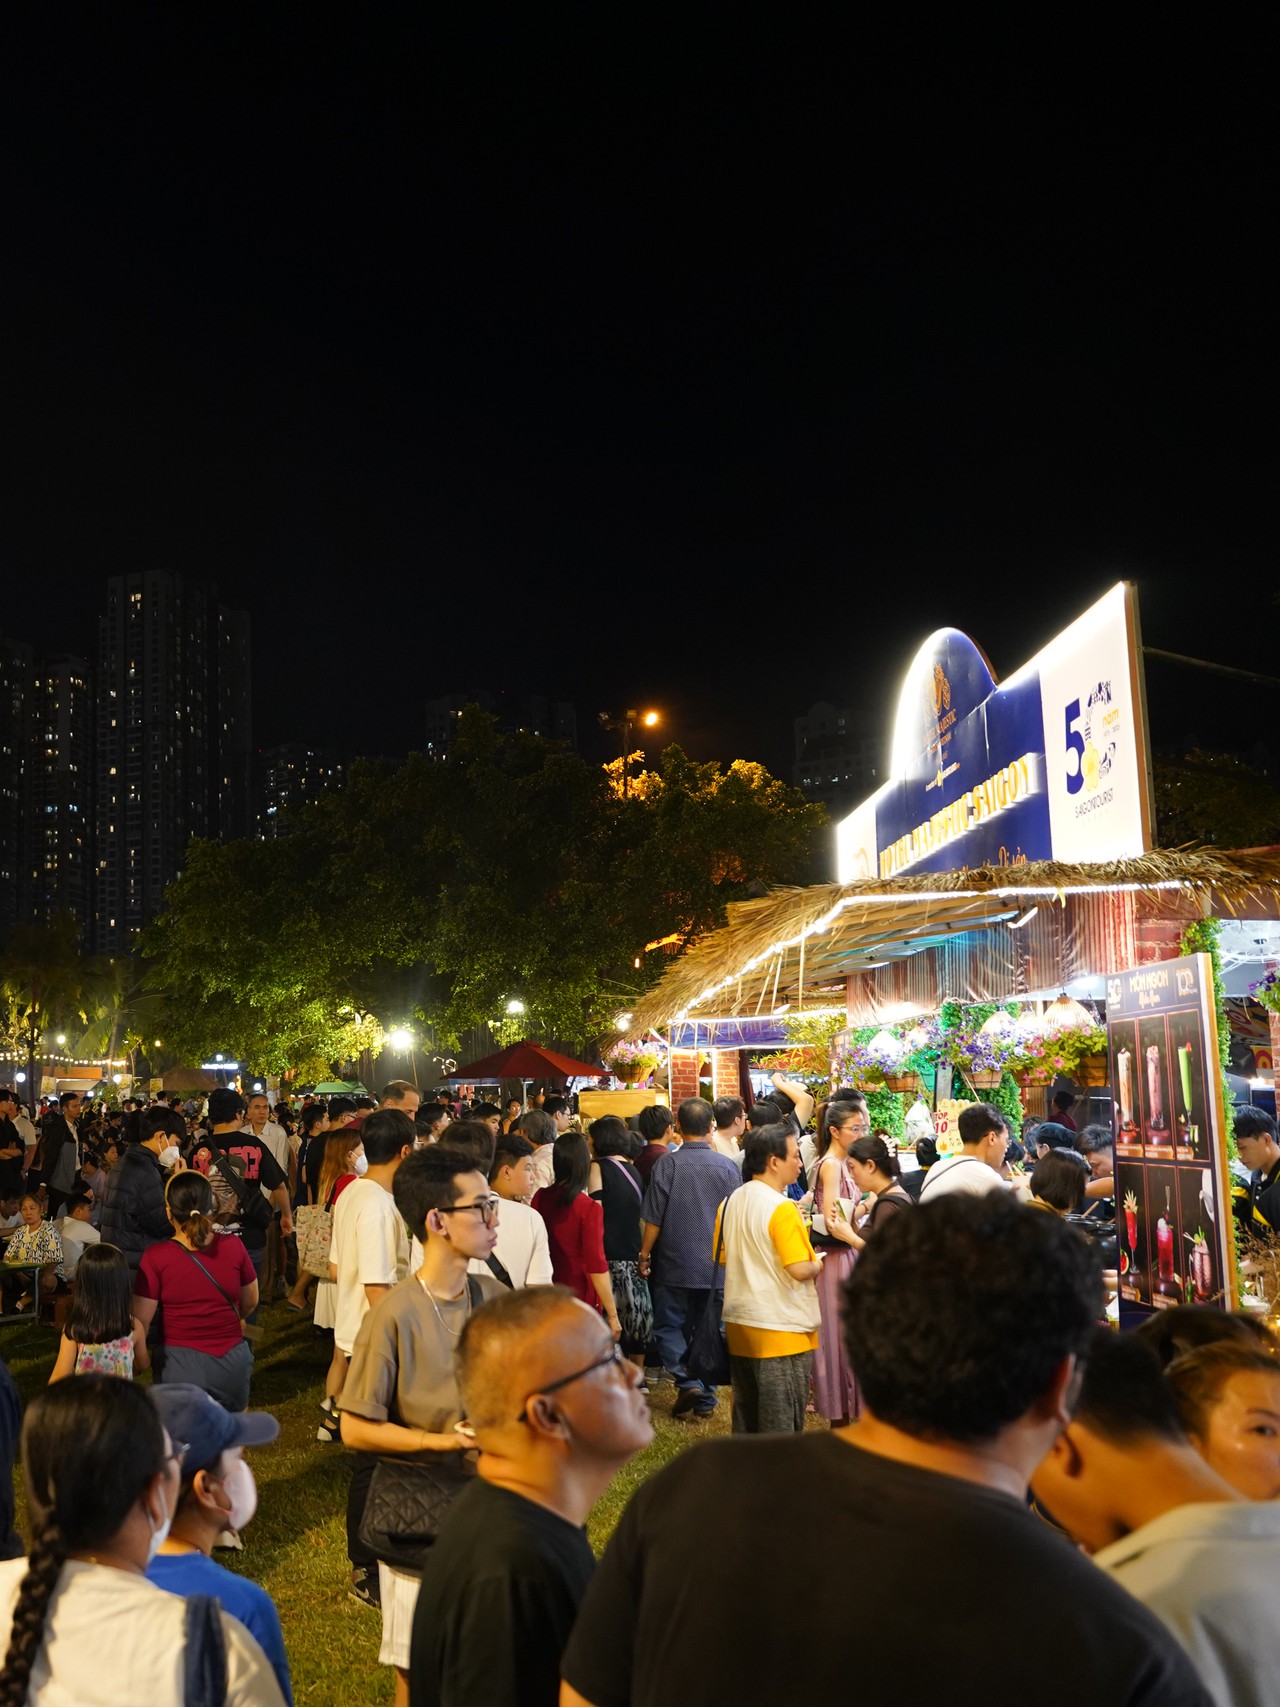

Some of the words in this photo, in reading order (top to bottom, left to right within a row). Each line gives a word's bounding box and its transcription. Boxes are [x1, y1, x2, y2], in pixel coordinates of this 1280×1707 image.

[972, 752, 1038, 824] SAIGON
[1074, 788, 1114, 819] SAIGONTOURIST
[934, 1111, 948, 1120] TOP
[934, 1121, 948, 1134] 10
